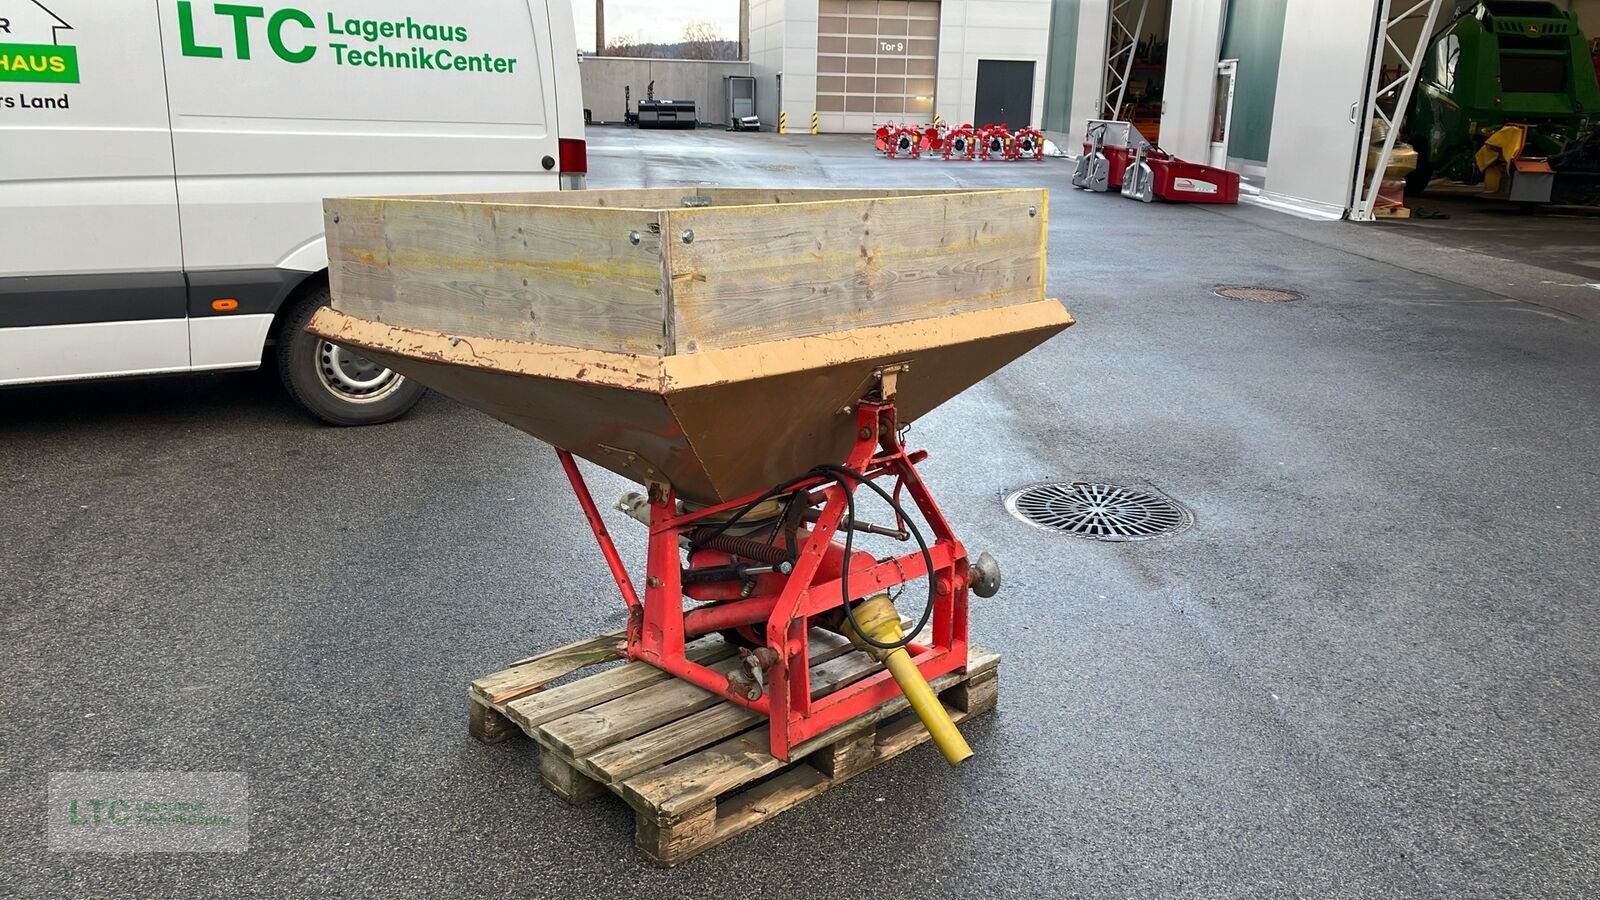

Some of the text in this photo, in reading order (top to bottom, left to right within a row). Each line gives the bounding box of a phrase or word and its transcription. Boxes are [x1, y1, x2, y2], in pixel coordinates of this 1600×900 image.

[176, 0, 318, 64] LTC
[327, 12, 468, 42] Lagerhaus
[328, 42, 517, 73] TechnikCenter
[880, 42, 904, 51] Tor 9
[20, 93, 70, 109] Land
